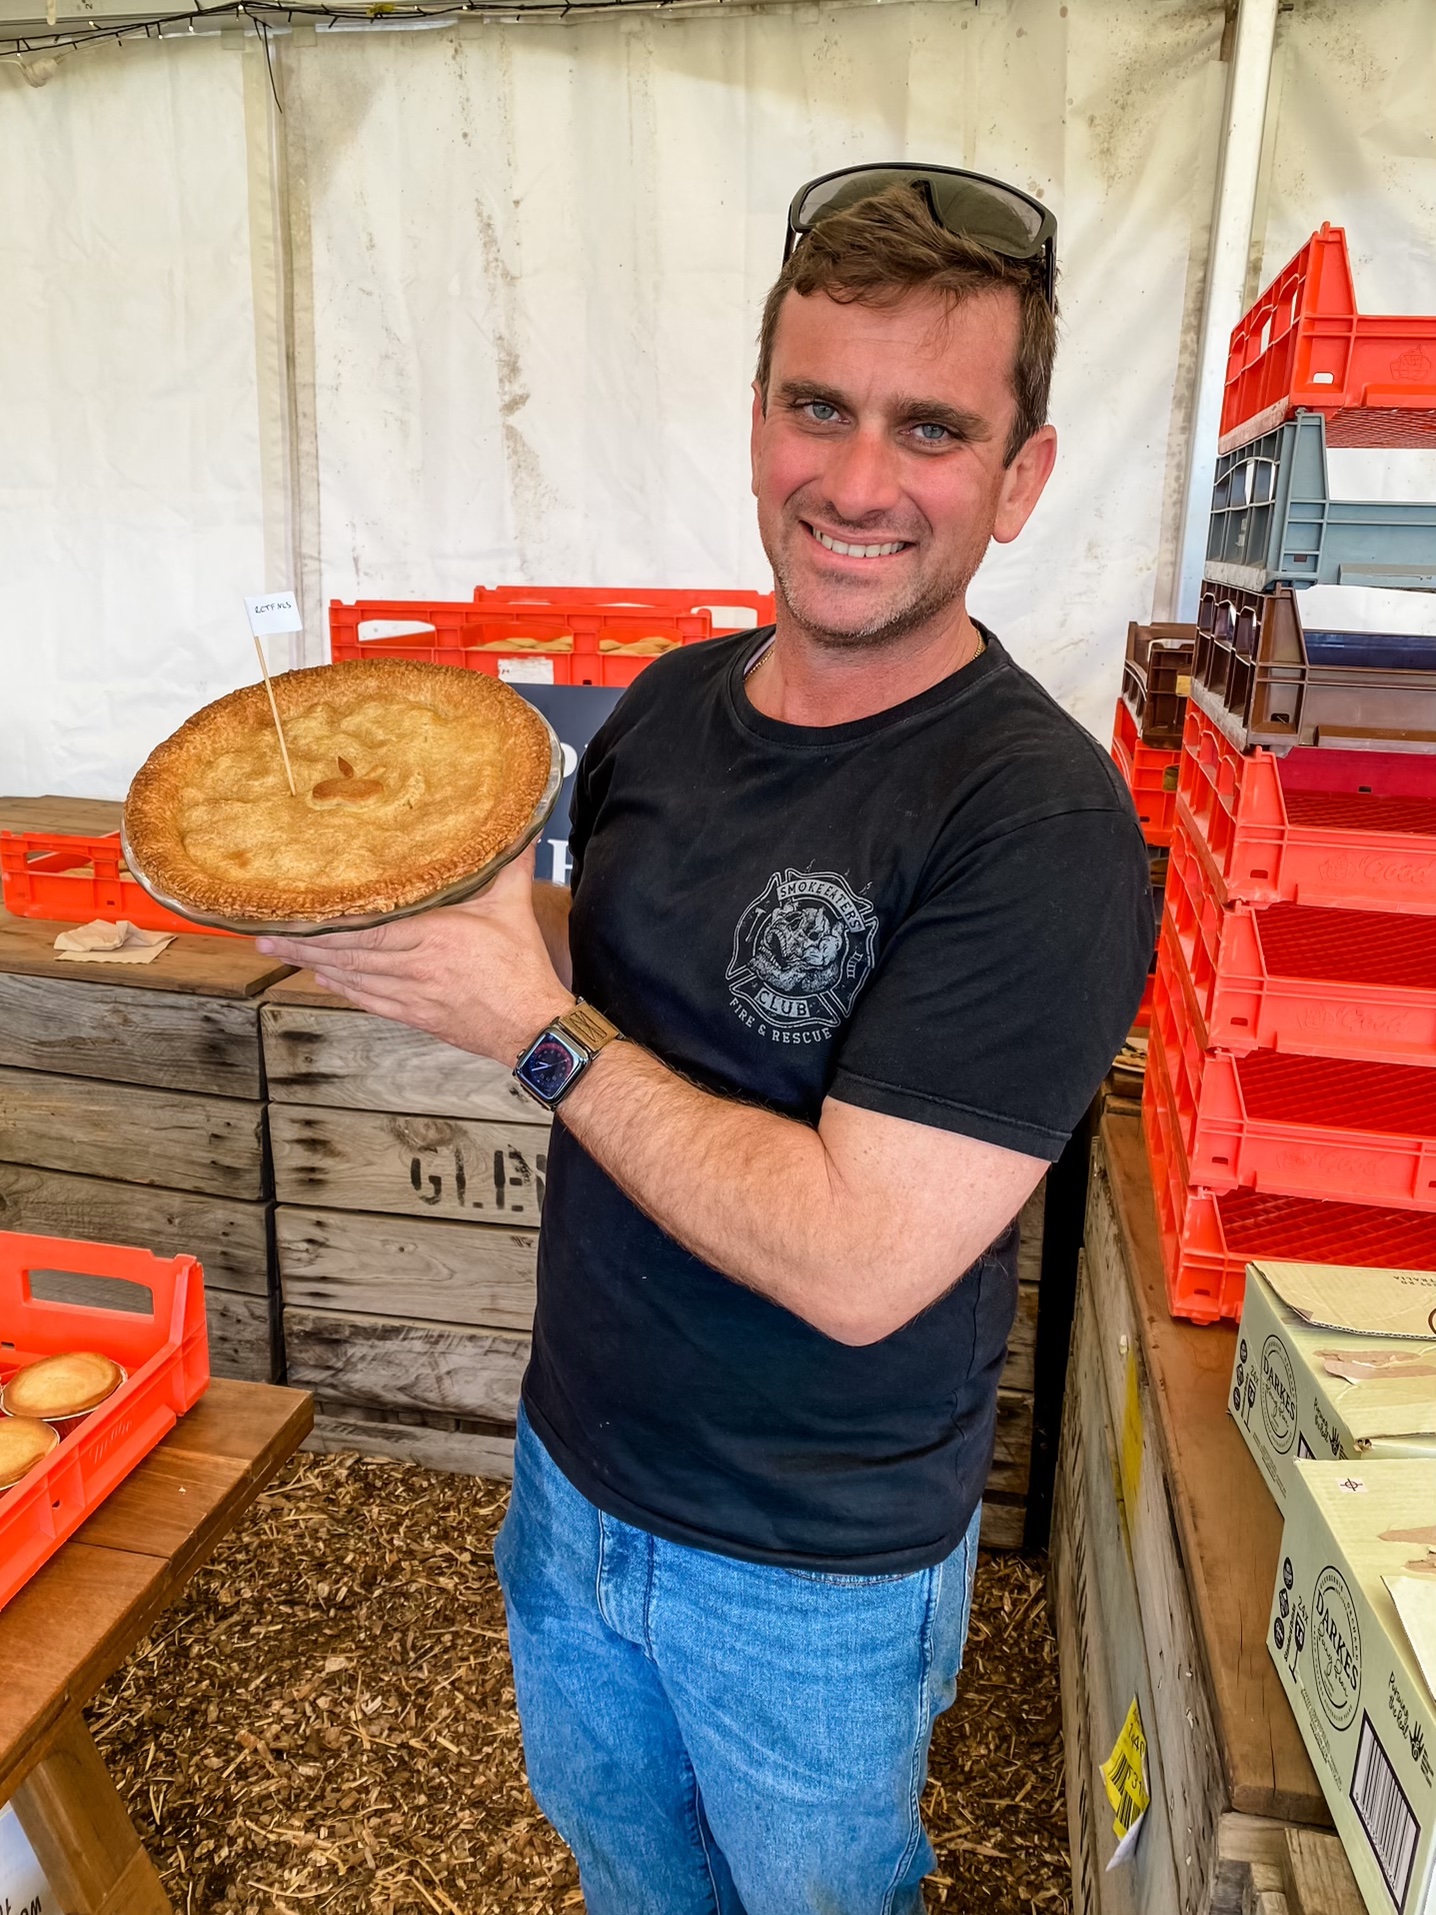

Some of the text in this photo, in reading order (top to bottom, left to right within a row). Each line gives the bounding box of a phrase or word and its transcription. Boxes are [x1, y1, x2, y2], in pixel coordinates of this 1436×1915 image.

[729, 997, 832, 1044] FIRE & RESCUE
[760, 990, 807, 1016] CLUB
[1263, 1355, 1296, 1421] DARKES
[1316, 1588, 1359, 1691] DARKES
